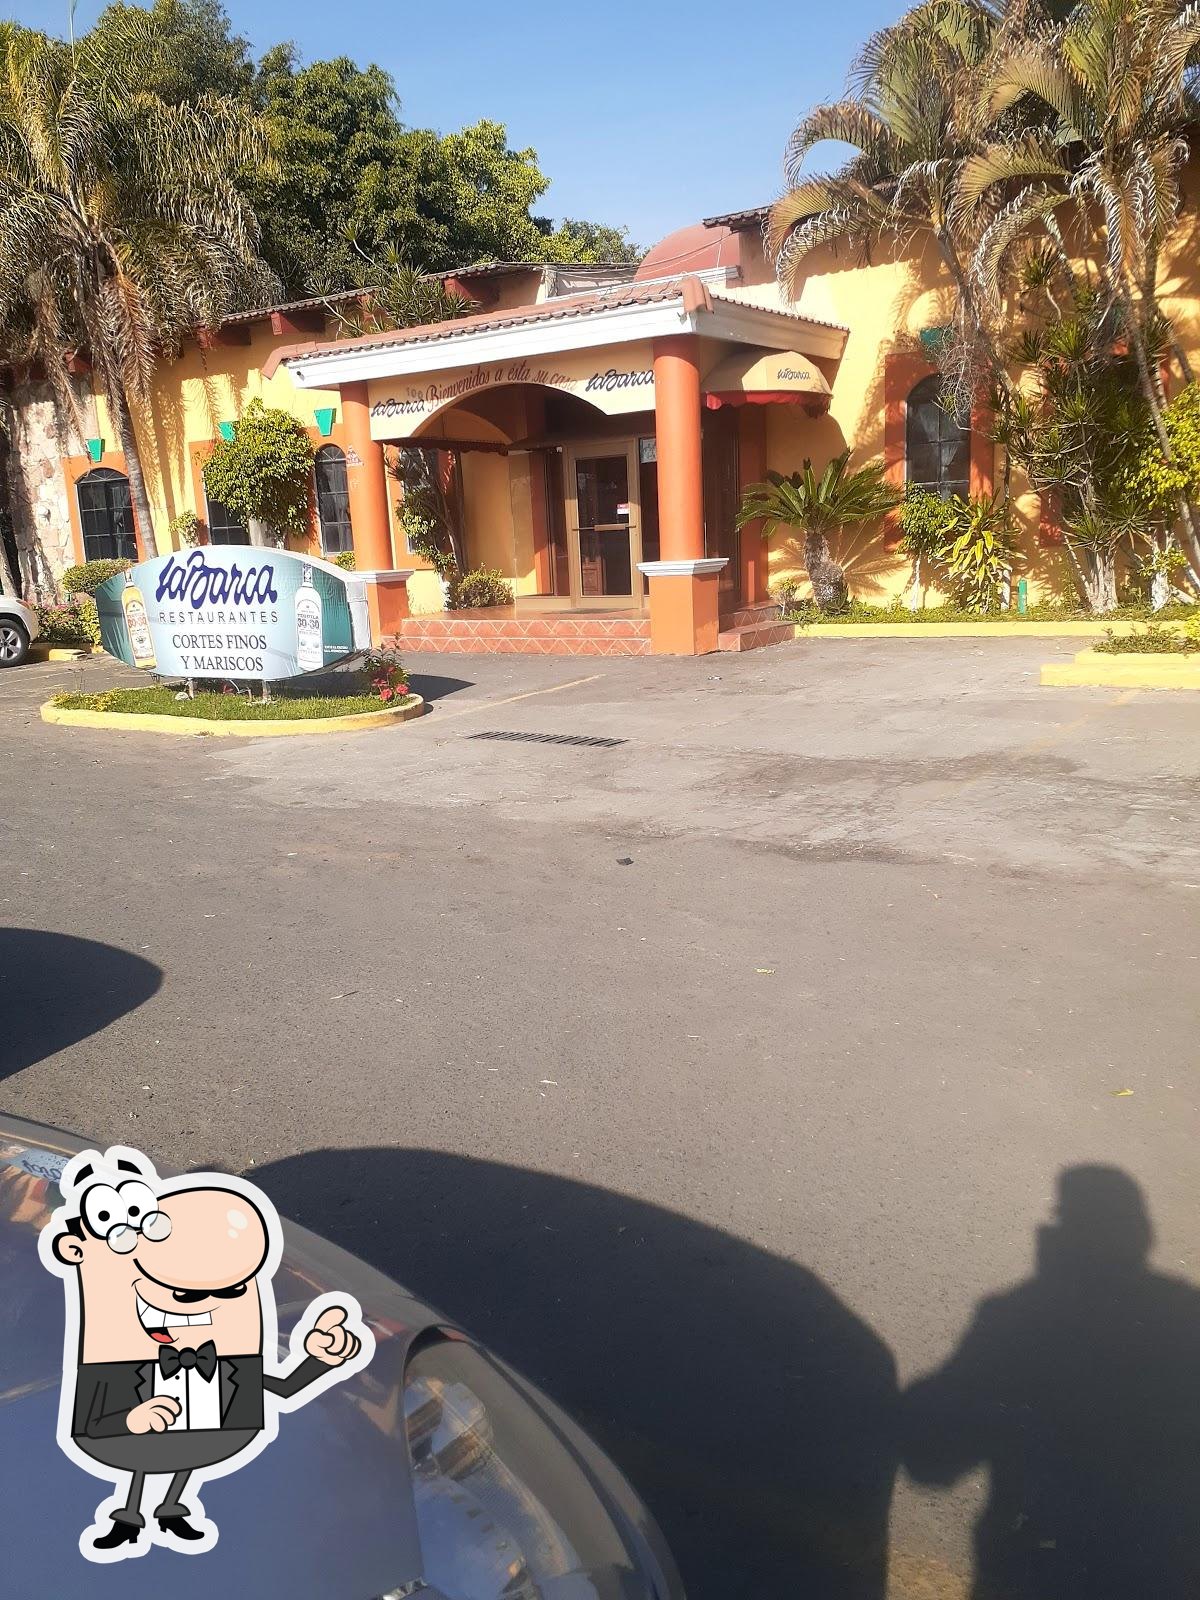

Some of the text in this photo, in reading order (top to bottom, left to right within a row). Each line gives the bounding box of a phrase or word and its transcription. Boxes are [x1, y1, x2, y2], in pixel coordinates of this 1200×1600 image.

[159, 611, 278, 623] RESTAURANTES
[172, 634, 267, 650] CORTES FINOS
[182, 656, 264, 671] Y MARISCOS
